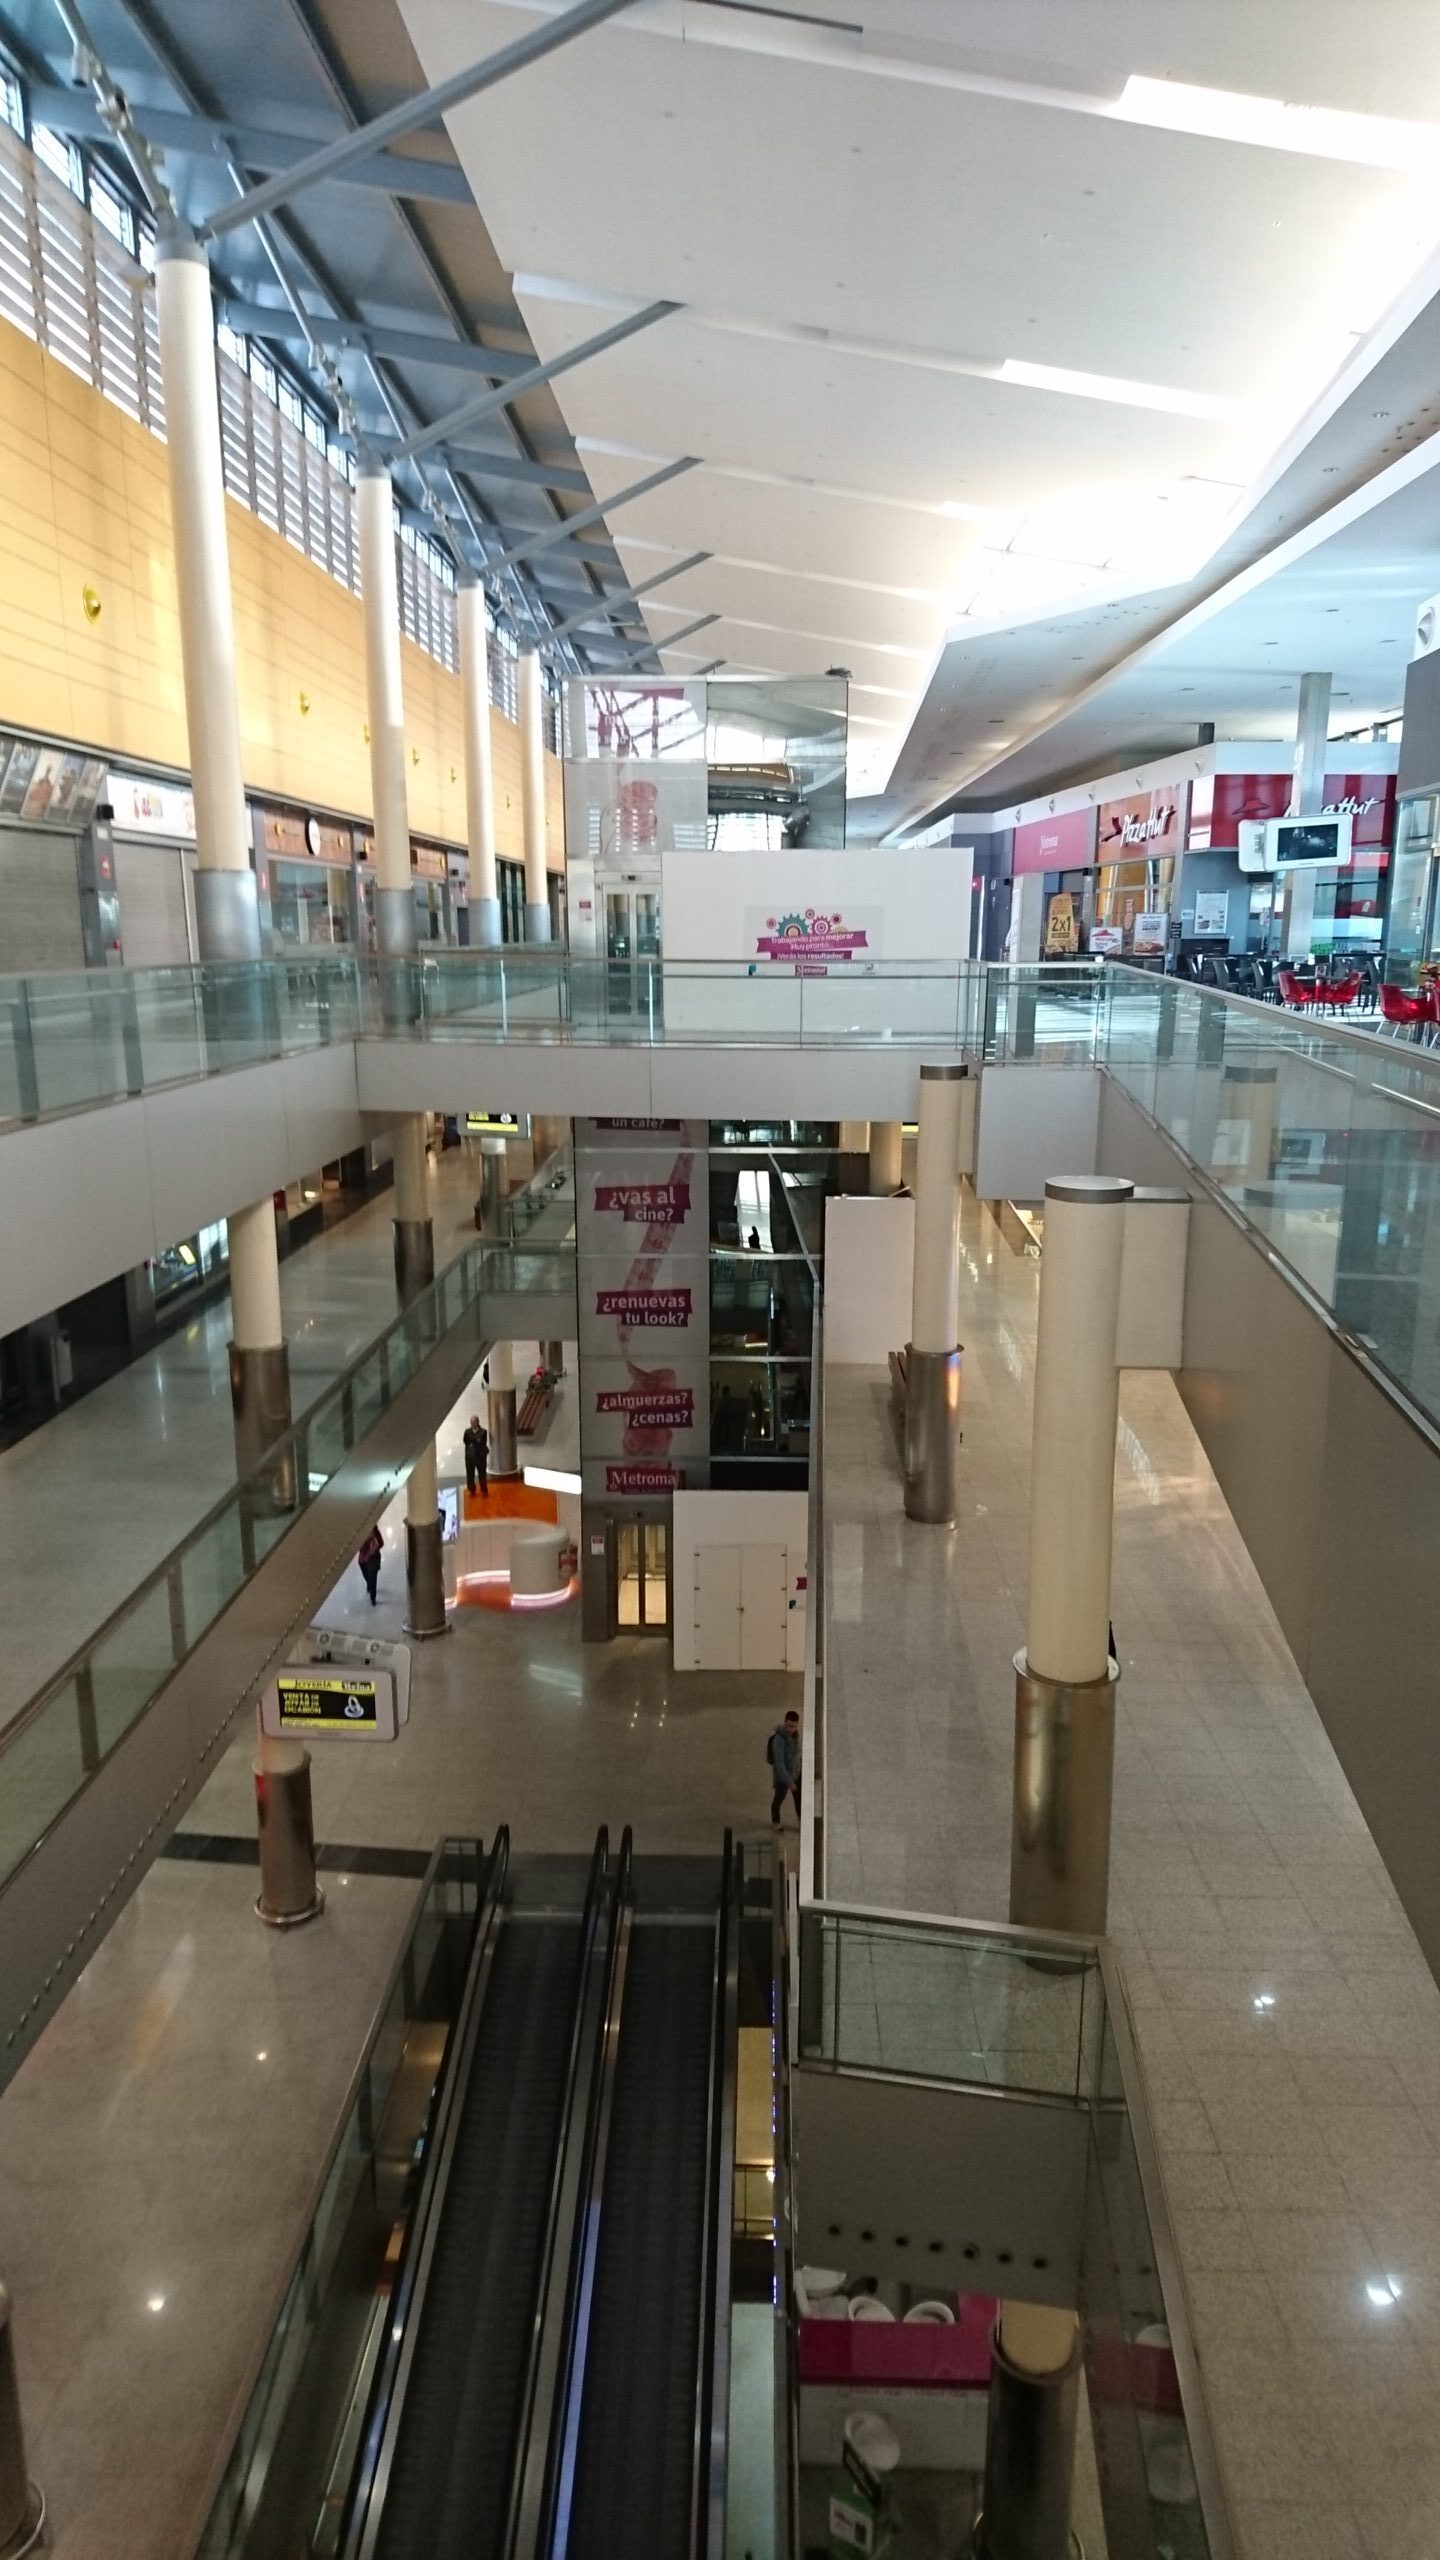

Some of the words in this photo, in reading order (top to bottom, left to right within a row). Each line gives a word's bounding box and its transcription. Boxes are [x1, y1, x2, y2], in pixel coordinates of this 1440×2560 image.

[1120, 814, 1146, 847] Pizza
[1145, 806, 1170, 840] Hut
[1051, 916, 1071, 932] 2x1
[809, 935, 825, 943] para
[826, 933, 853, 942] mejorar
[807, 952, 844, 960] resultados!
[612, 1118, 628, 1128] un
[609, 1190, 651, 1209] ¿vas
[657, 1186, 676, 1204] al
[635, 1206, 674, 1221] cine?
[603, 1296, 686, 1312] ¿renuevas
[626, 1312, 640, 1324] tu
[645, 1311, 685, 1325] look?
[602, 1392, 688, 1410] ¿almuerzas?
[632, 1410, 689, 1427] ¿cenas?
[610, 1471, 677, 1487] Metroma
